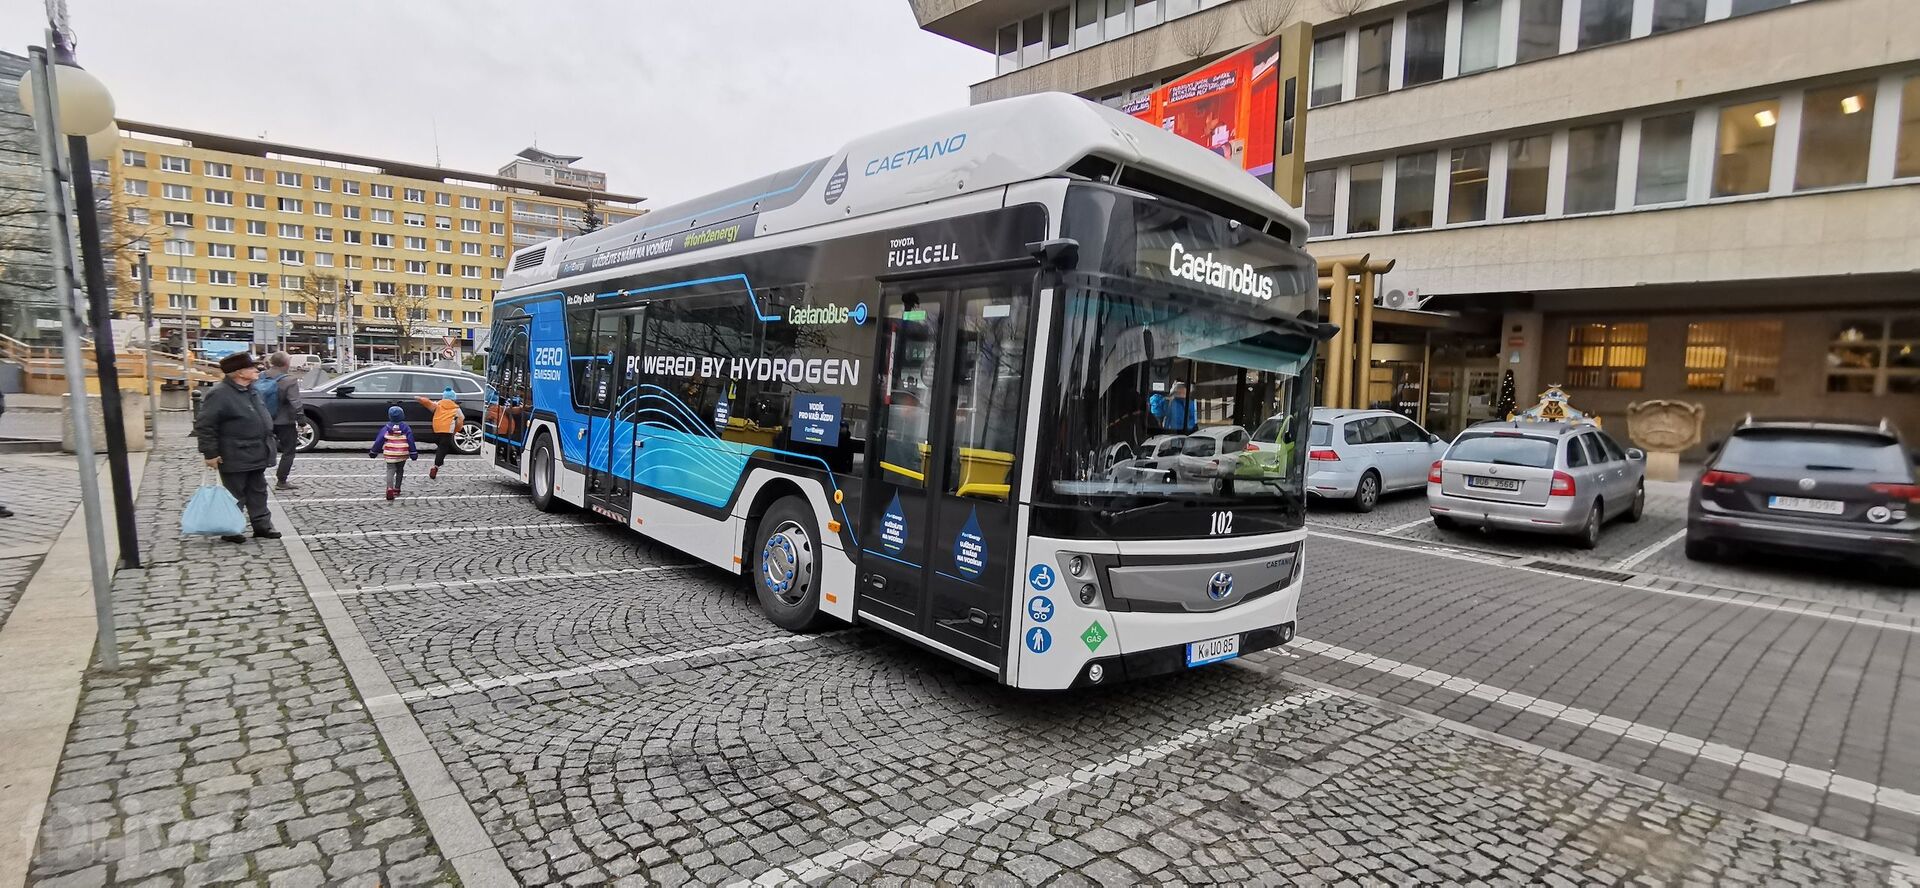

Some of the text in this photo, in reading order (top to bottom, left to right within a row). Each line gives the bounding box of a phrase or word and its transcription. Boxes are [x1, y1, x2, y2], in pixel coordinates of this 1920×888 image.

[865, 132, 967, 178] CAETANO
[684, 224, 740, 249] #forh2energy
[890, 237, 915, 248] TOYOTA
[887, 243, 959, 268] FUELCELL
[1169, 242, 1273, 301] CaetanoBus
[583, 292, 595, 303] Gold
[788, 303, 849, 325] CaetanoBus
[535, 347, 563, 366] ZERO
[533, 369, 562, 381] EMISSION
[700, 357, 725, 378] BY
[730, 357, 860, 386] HYDROGEN
[809, 401, 824, 411] VODÍK
[798, 411, 833, 421] PRO VAŠI JÍZDU
[1210, 511, 1233, 535] 102
[1086, 635, 1102, 643] GAS
[1199, 644, 1205, 659] K
